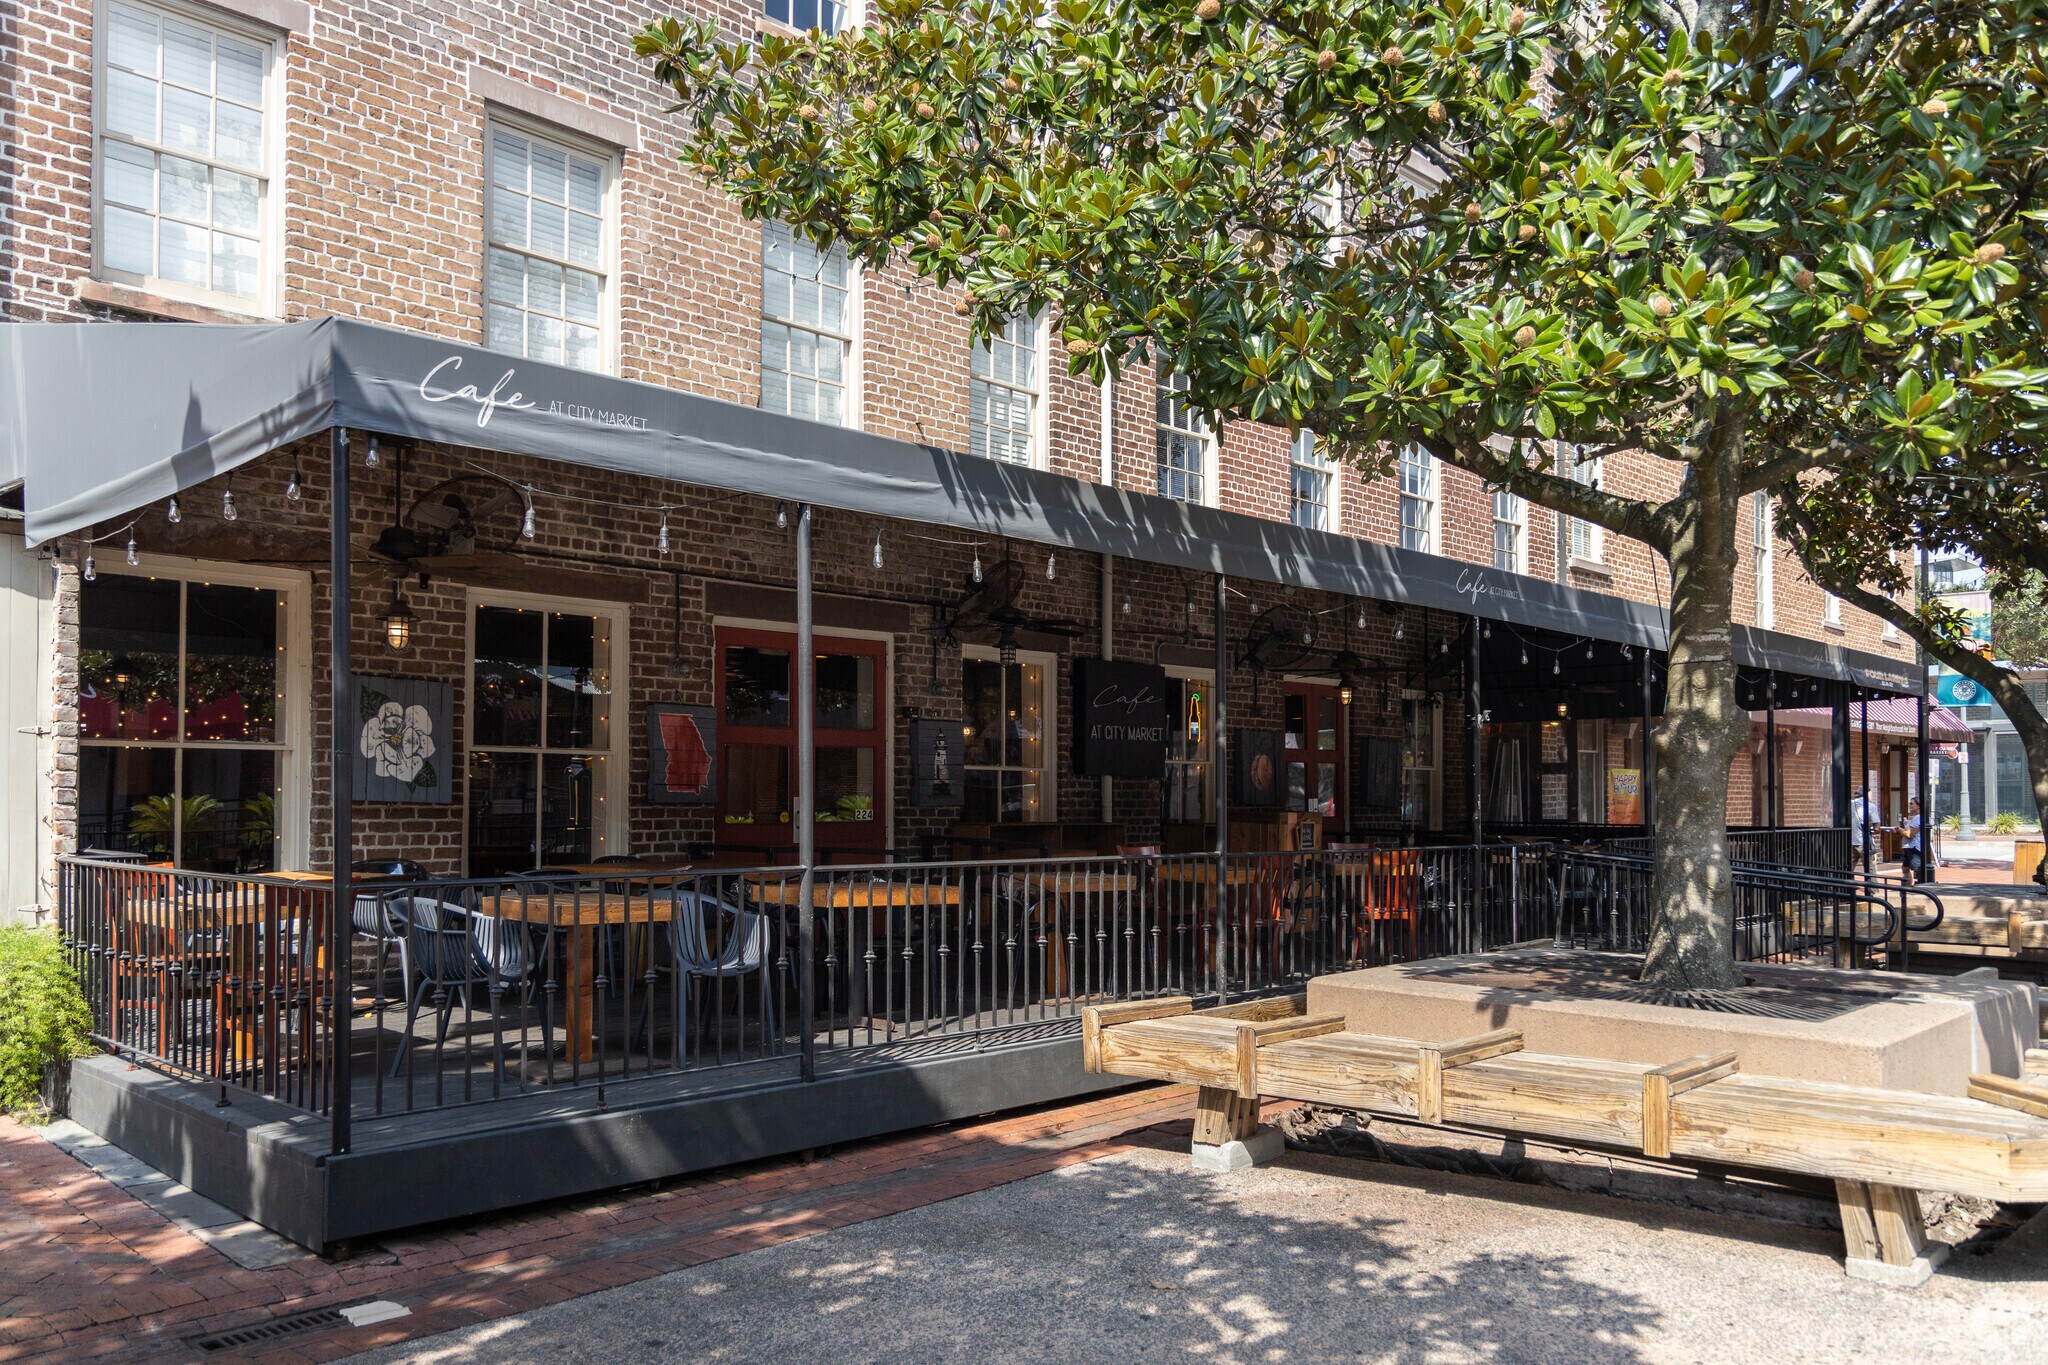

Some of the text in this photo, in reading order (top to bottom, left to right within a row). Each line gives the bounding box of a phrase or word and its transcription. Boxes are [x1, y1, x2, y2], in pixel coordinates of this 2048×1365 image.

[420, 356, 648, 432] Cafe AT CITY MARKET
[1456, 568, 1487, 605] Cafe
[1093, 684, 1162, 714] Cafe
[1091, 725, 1164, 742] AT CITY MARKET
[1614, 774, 1638, 783] HAPPY
[856, 810, 873, 820] 224
